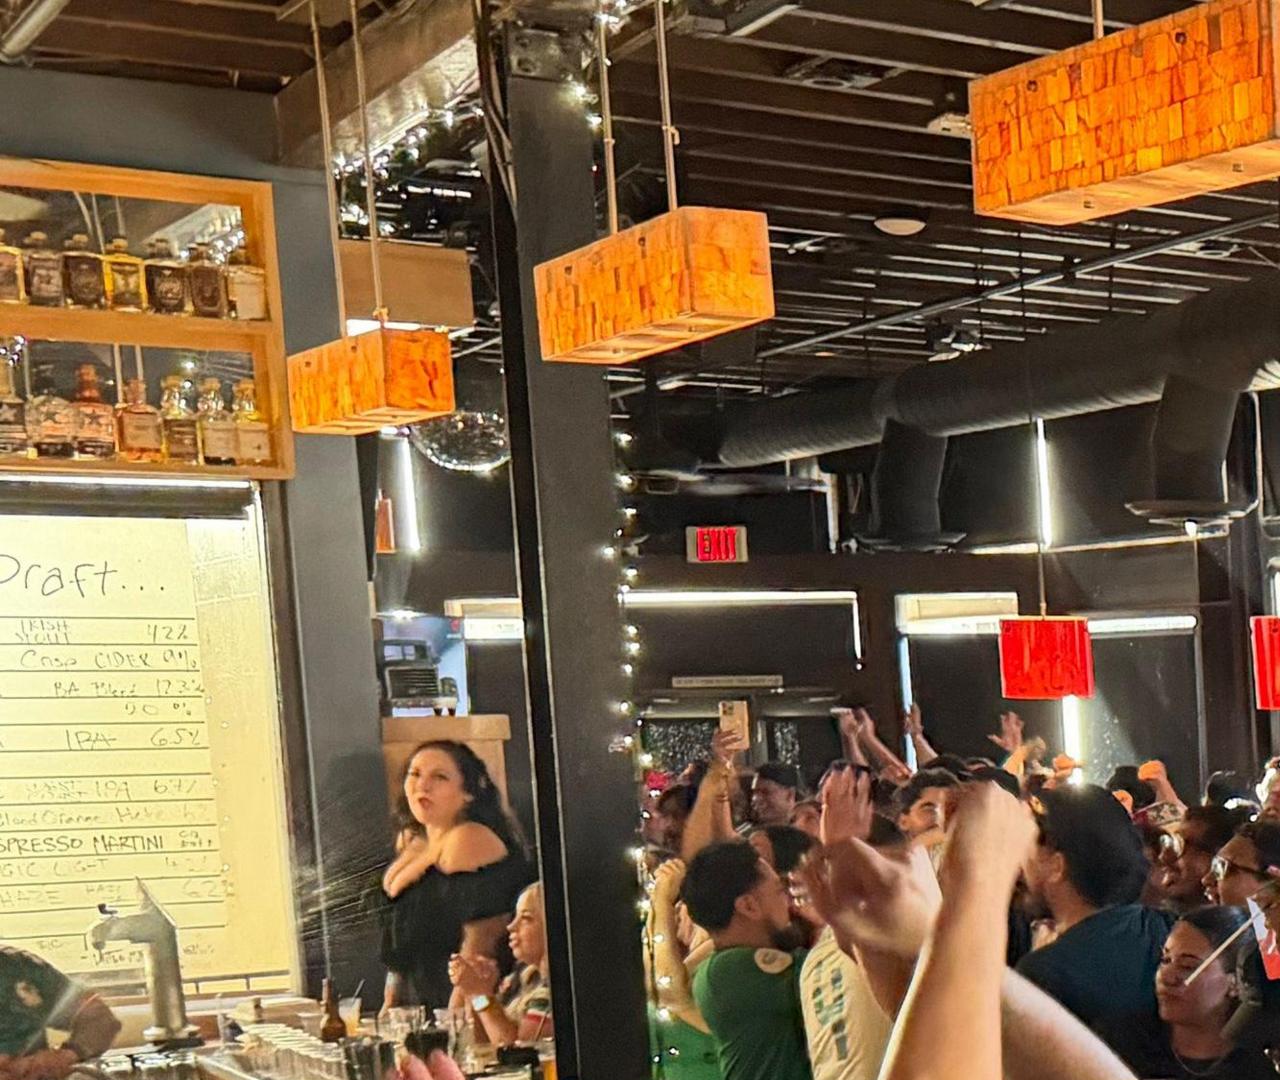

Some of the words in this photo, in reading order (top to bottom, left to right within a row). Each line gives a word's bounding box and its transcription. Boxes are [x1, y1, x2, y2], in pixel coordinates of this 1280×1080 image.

[697, 528, 737, 561] EXIT
[0, 836, 83, 856] SPRESSO
[93, 834, 164, 855] MARTINI
